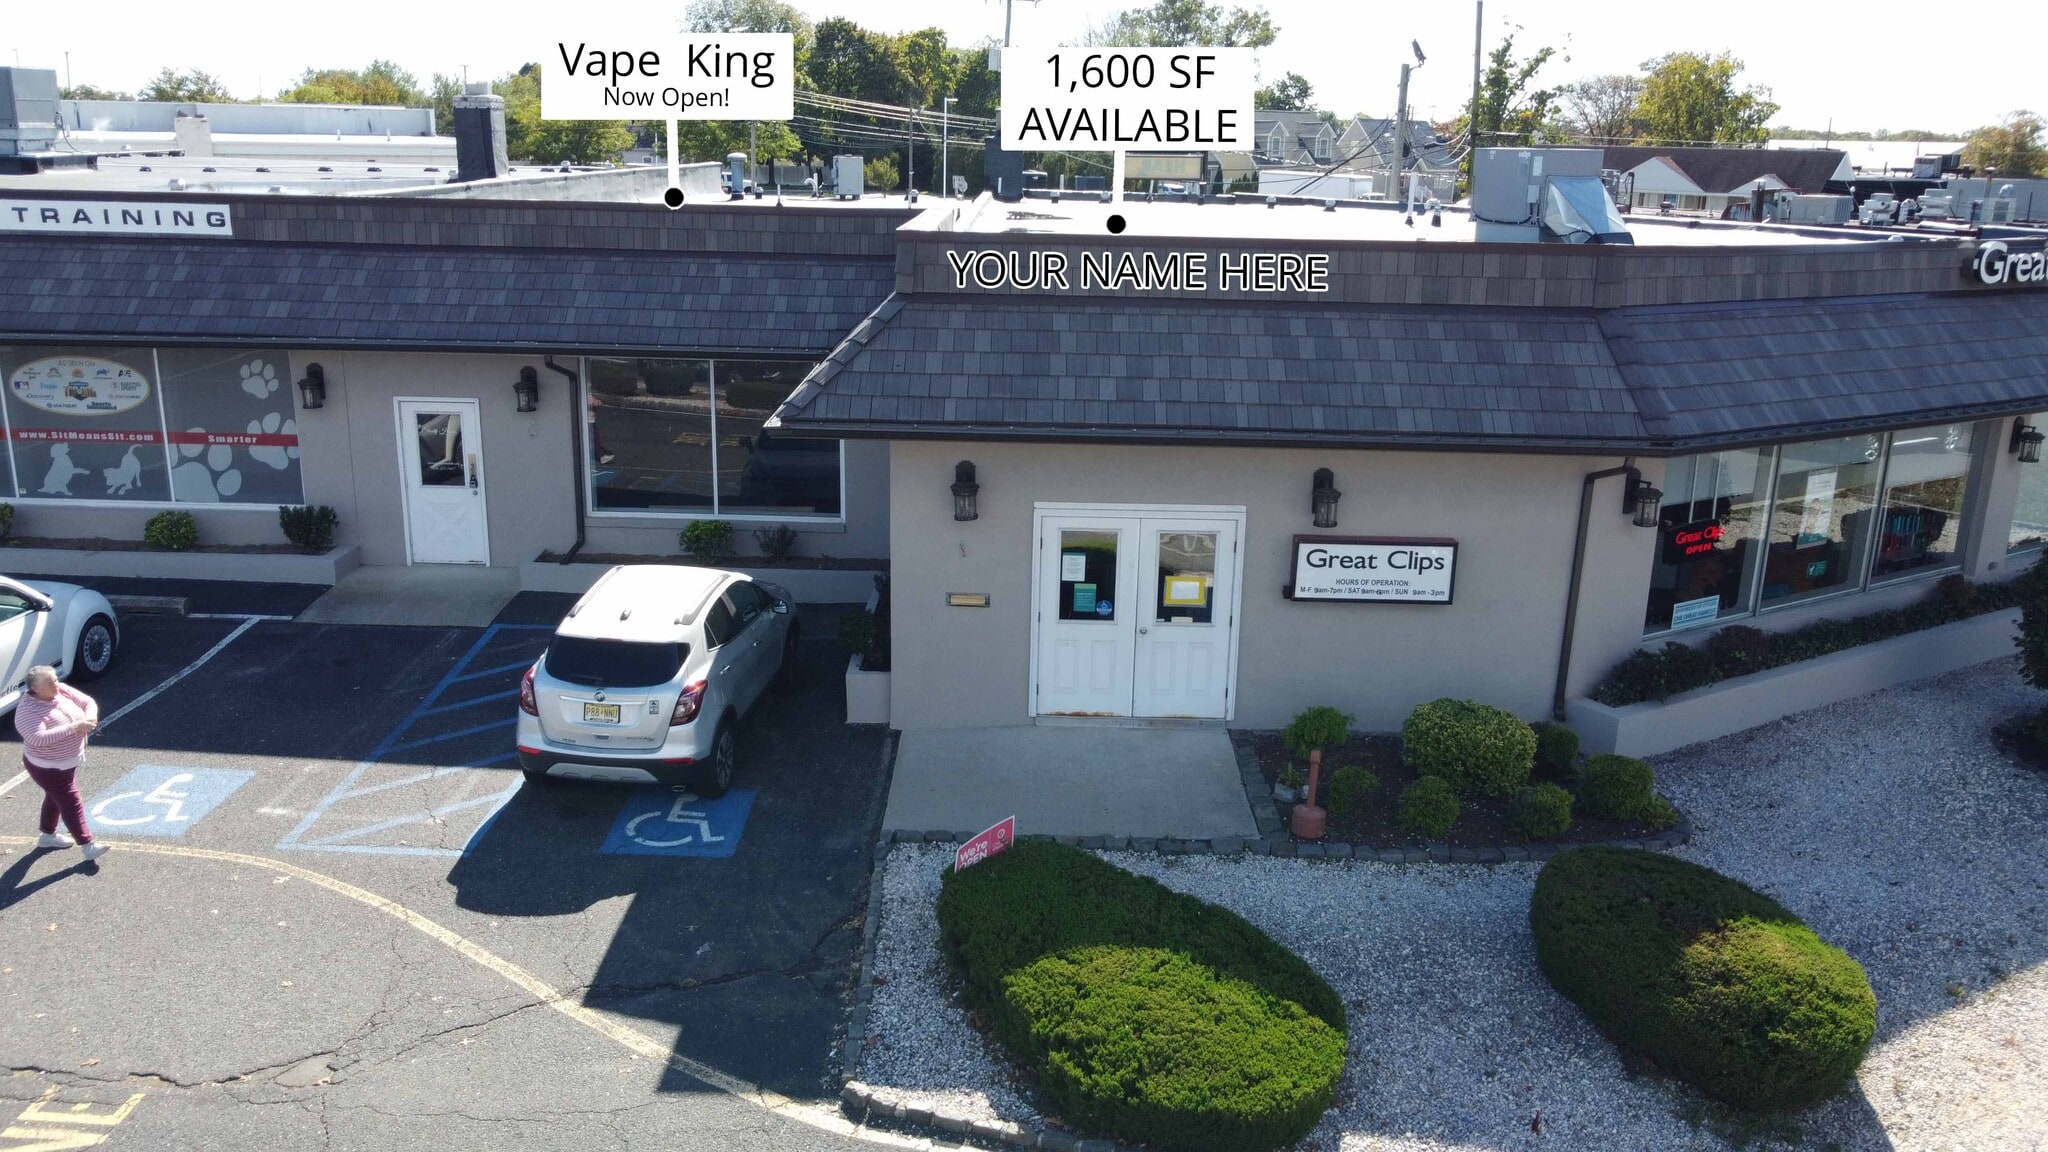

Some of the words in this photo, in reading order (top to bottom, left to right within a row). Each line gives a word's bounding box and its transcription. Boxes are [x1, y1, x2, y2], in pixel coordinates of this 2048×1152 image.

[11, 206, 227, 228] TRAINING
[19, 431, 154, 441] www.SitMeansSit.com
[208, 435, 257, 443] Smarter
[1685, 542, 1713, 555] OPEN
[1306, 548, 1378, 569] Great
[1387, 550, 1445, 575] Clips
[1335, 578, 1360, 586] HOURS
[1371, 579, 1411, 587] OPERATION:
[959, 849, 988, 870] OPEN
[960, 840, 988, 862] We're
